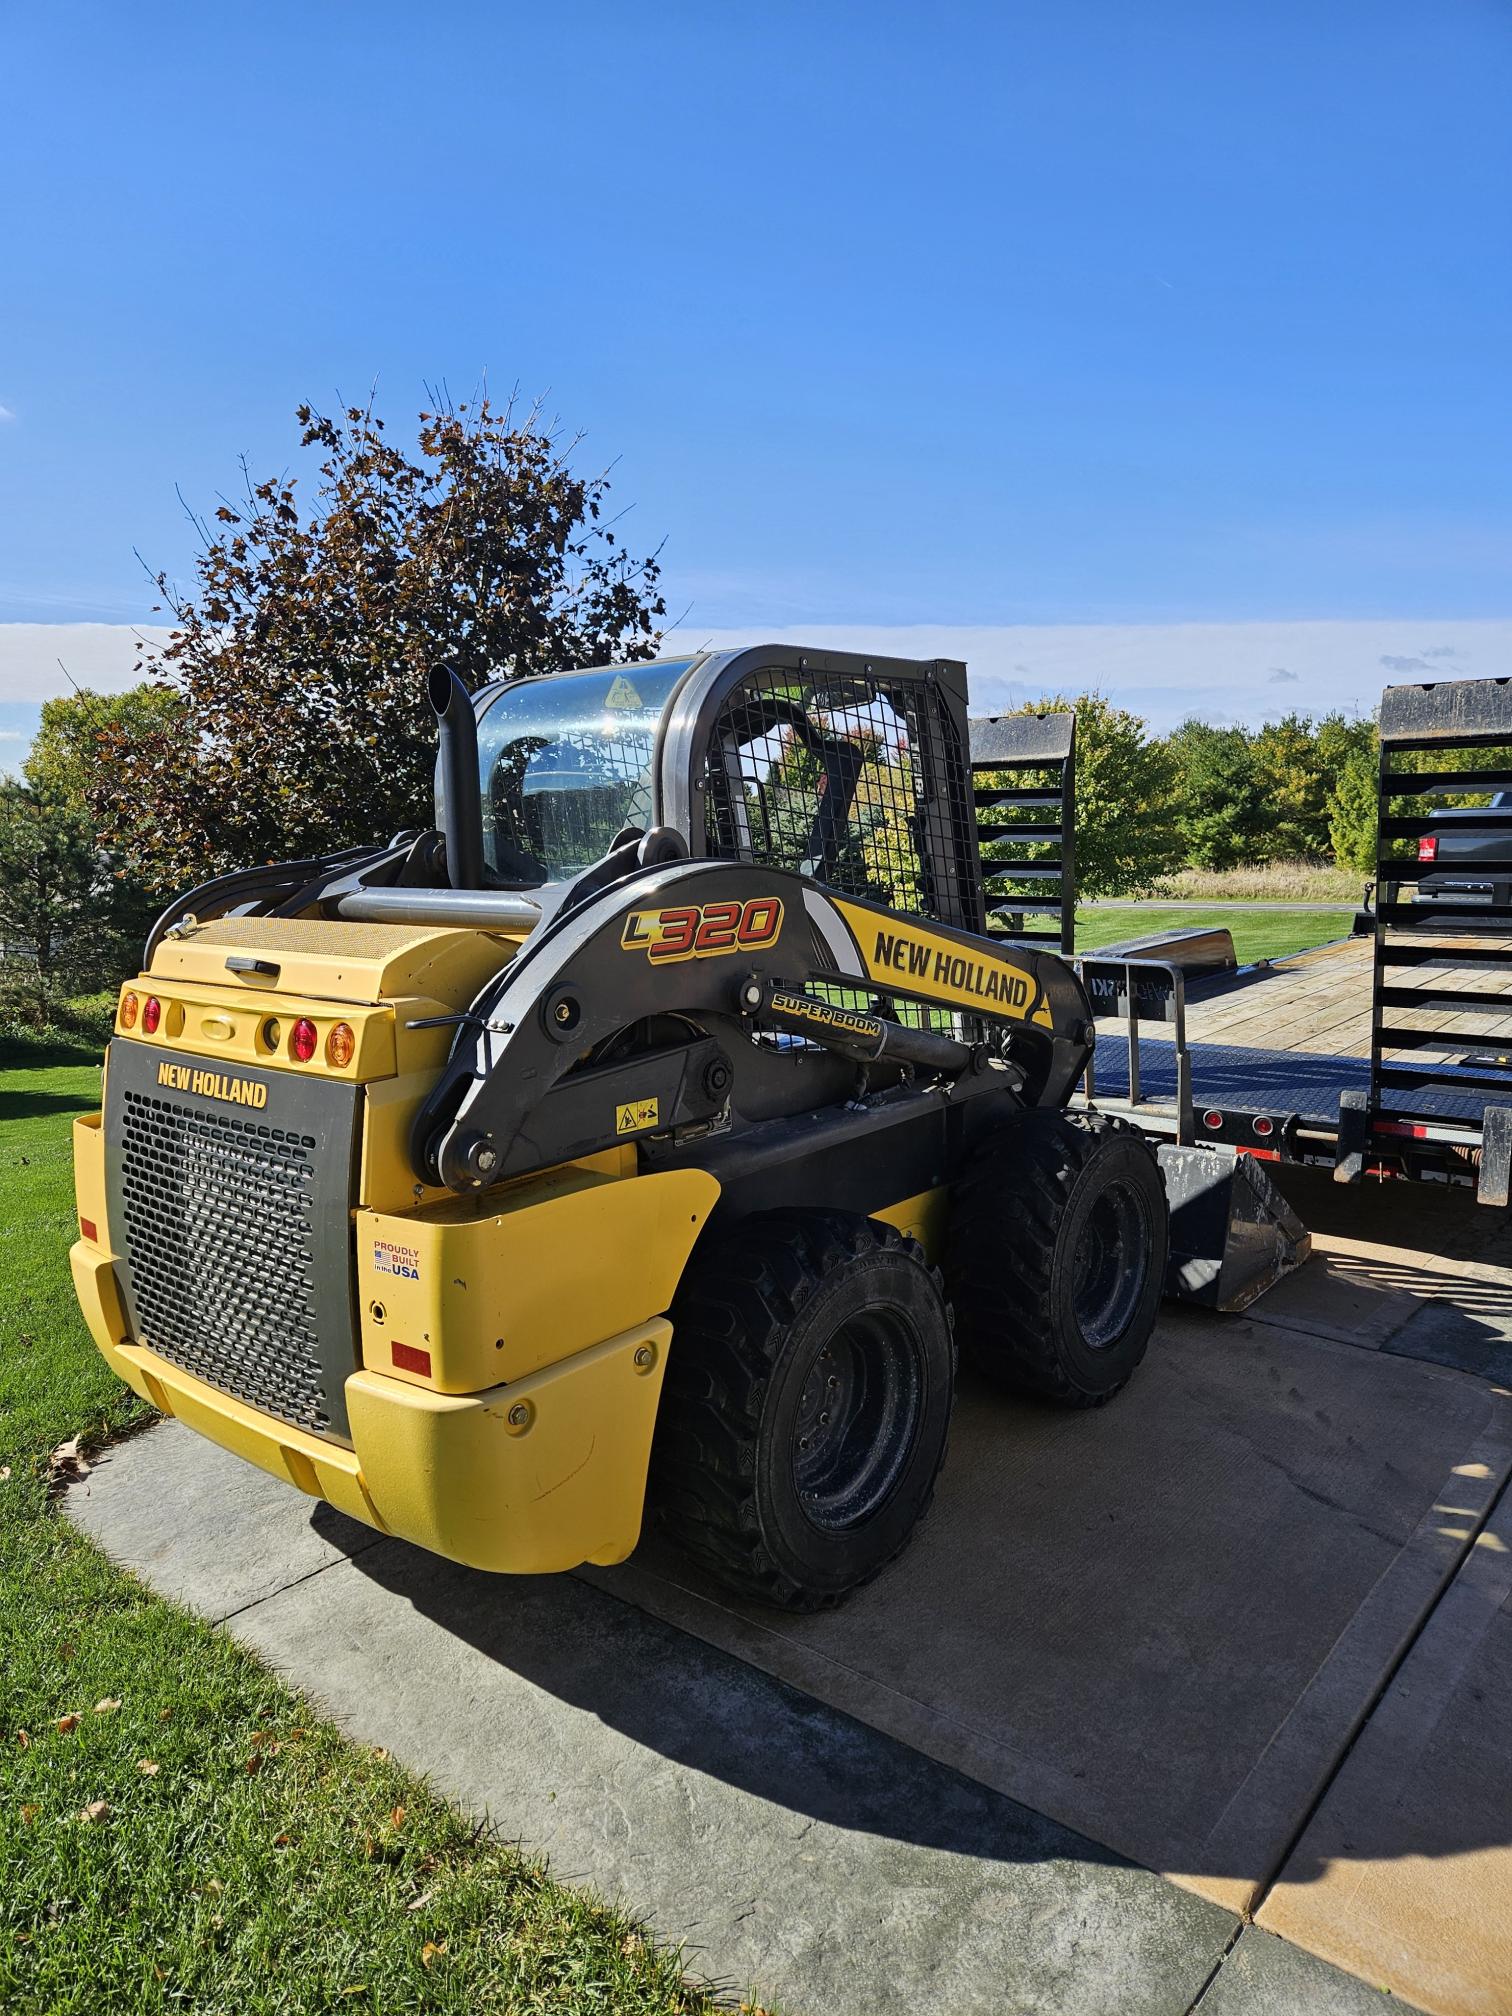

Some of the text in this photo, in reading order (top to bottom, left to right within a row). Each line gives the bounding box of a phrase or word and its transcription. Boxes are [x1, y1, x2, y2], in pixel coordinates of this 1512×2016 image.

[621, 897, 784, 965] L320
[873, 931, 1028, 1008] NEW HOLLAND
[771, 993, 881, 1037] SUPER BOOM
[157, 1062, 267, 1109] NEW HOLLAND
[374, 1240, 419, 1258] PROUDLY
[392, 1254, 420, 1268] BUILT
[381, 1265, 392, 1274] the
[392, 1263, 420, 1281] USA
